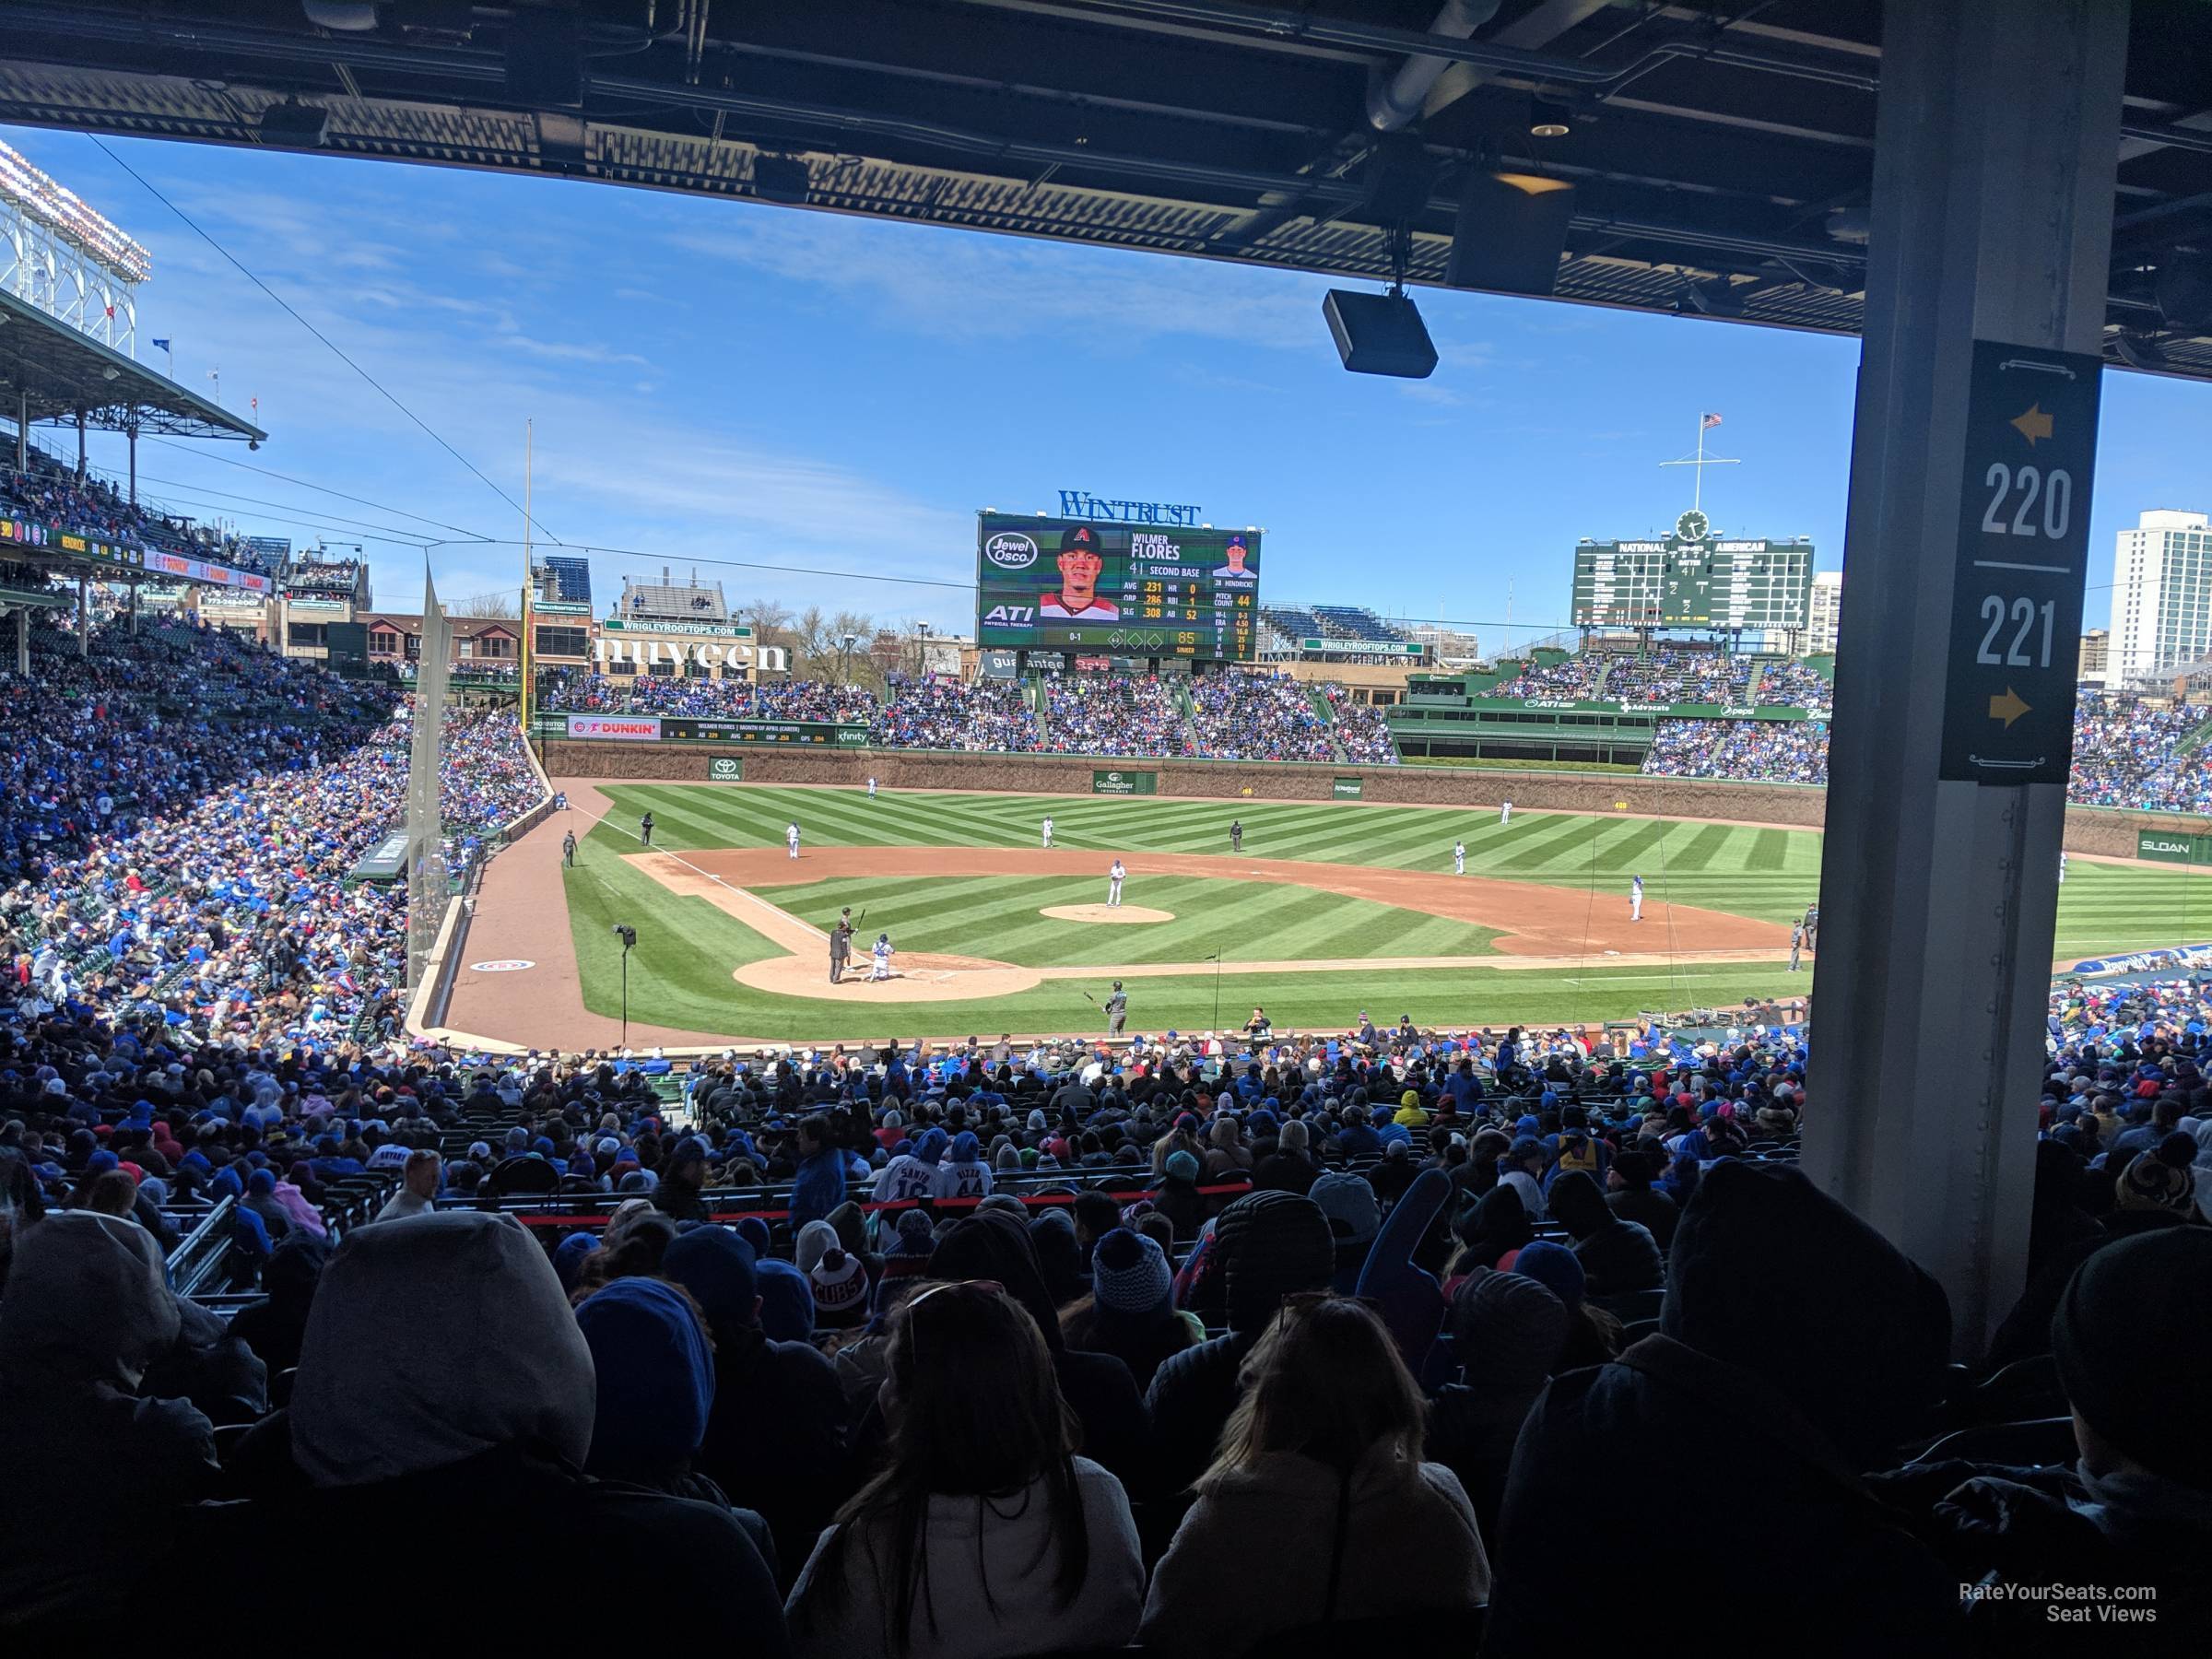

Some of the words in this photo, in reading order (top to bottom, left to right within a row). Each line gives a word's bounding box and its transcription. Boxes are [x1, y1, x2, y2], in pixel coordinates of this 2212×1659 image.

[1982, 462, 2072, 539] 220
[1058, 490, 1201, 525] WINTRUST
[42, 528, 48, 546] 2
[1133, 533, 1169, 545] WILMER
[993, 538, 1030, 552] Jewel
[1619, 543, 1667, 553] NATIONAL
[1715, 542, 1766, 552] AMERICAN
[994, 550, 1028, 562] Osco
[1131, 543, 1181, 560] FLORES
[1149, 566, 1180, 576] SECOND
[1182, 568, 1200, 578] BASE
[1681, 566, 1695, 577] 41
[1124, 582, 1137, 590] AVG
[1144, 582, 1162, 593] .231
[1168, 584, 1178, 593] HR
[1190, 583, 1196, 594] 0
[1669, 585, 1677, 595] 2
[1700, 585, 1704, 595] 1
[1144, 595, 1162, 606] .286
[1190, 597, 1195, 606] 1
[1238, 595, 1250, 606] 44
[984, 605, 1034, 622] ATI
[1123, 607, 1135, 616] SLG
[1143, 608, 1161, 618] .308
[1167, 610, 1176, 618] AB
[1186, 610, 1197, 620] 52
[1682, 603, 1690, 614] 2
[622, 620, 736, 637] WRIGLEYROOFTOPS.COM
[1215, 618, 1227, 627] ERA
[1069, 632, 1081, 641] 0-1
[1977, 594, 2055, 668] 221
[1178, 631, 1195, 644] 85
[1321, 640, 1407, 653] WRIGLEYROOFTOPS.COM
[593, 638, 789, 672] nuveen
[1537, 700, 1559, 709] ATI
[1732, 708, 1755, 716] pepsi
[602, 723, 655, 735] DUNKIN'
[837, 731, 867, 743] xfinity
[712, 772, 739, 781] TOYOTA
[1096, 781, 1135, 790] Gallagher
[2141, 840, 2190, 853] SLOAN
[900, 1169, 930, 1184] SANTO
[898, 1180, 927, 1198] 10
[958, 1179, 983, 1196] 44
[816, 1277, 857, 1302] CUBS
